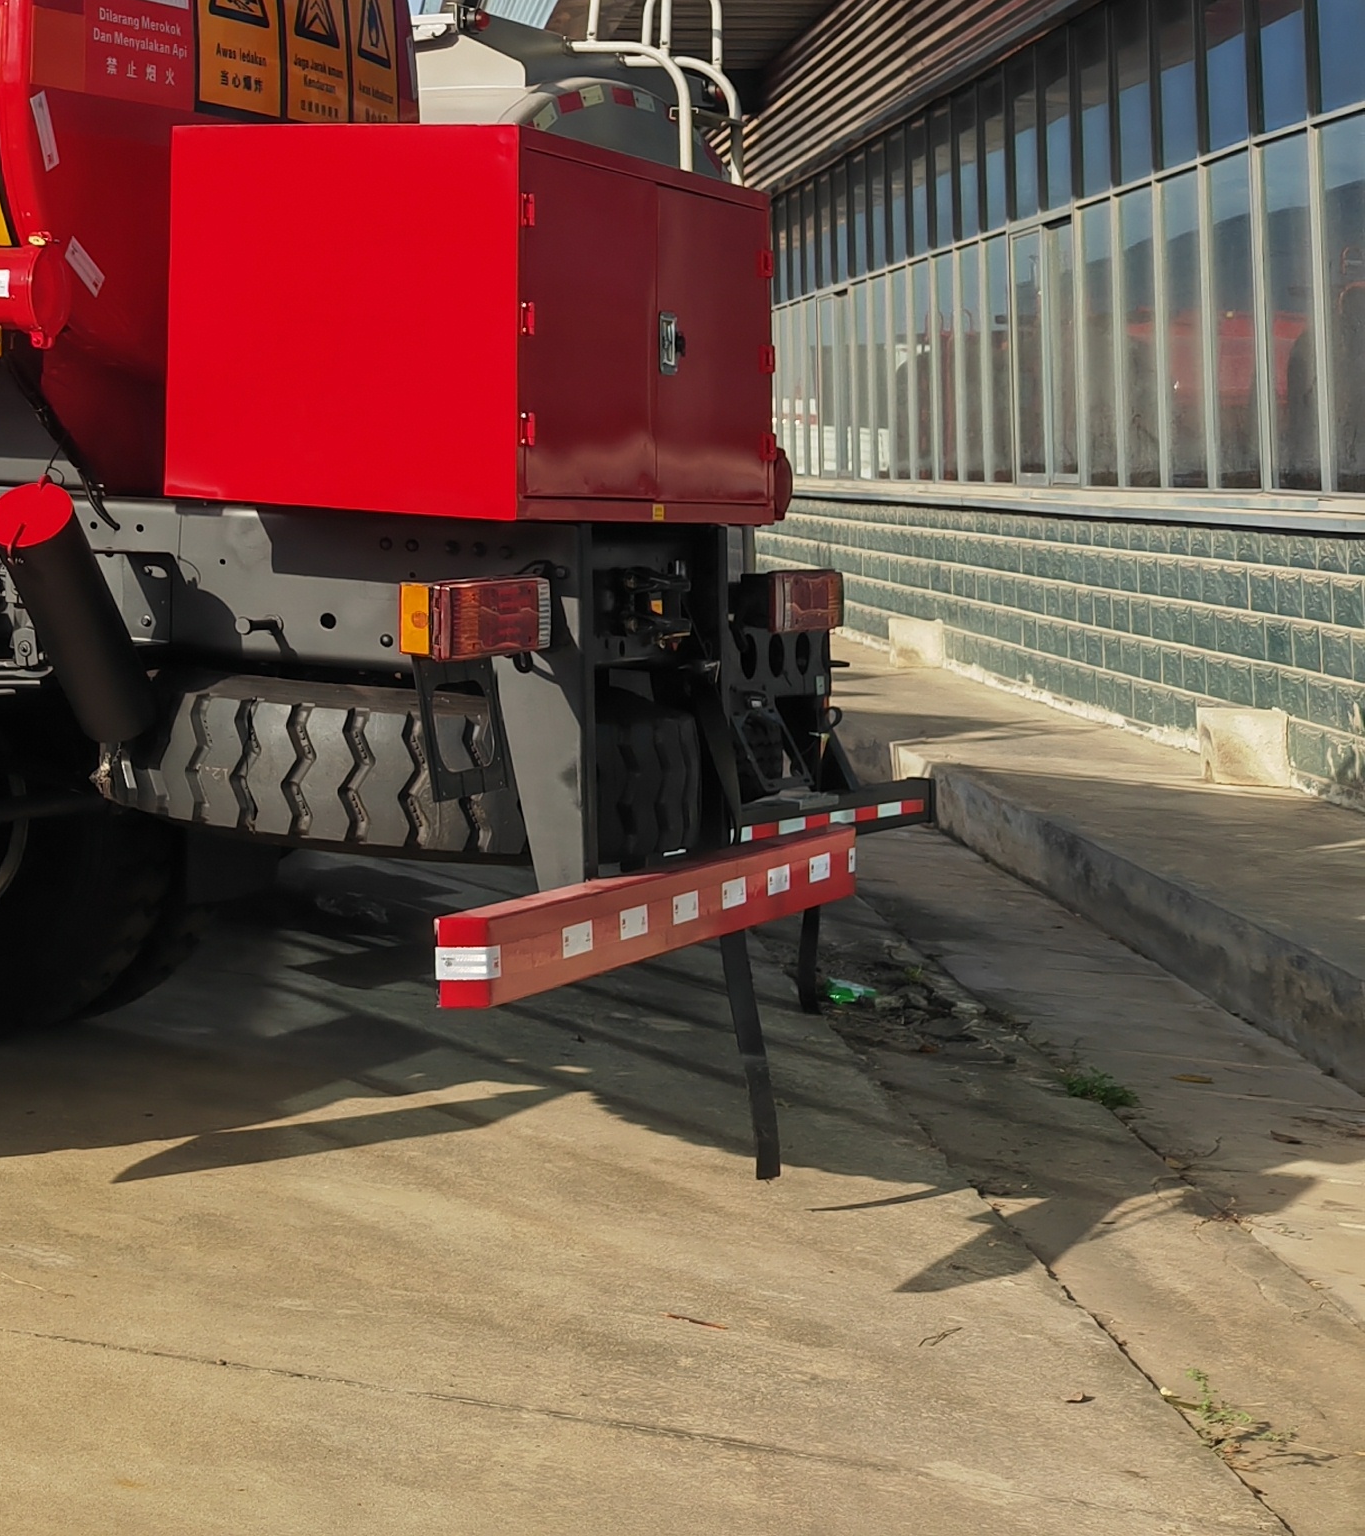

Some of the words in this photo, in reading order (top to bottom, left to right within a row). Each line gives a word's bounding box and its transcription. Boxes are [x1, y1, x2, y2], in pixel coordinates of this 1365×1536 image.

[98, 7, 140, 30] Dilarang
[141, 16, 182, 36] Merokok
[93, 27, 112, 43] Dan
[114, 31, 170, 55] Menyalakan
[172, 44, 188, 59] Api
[216, 42, 236, 60] Awas
[239, 48, 267, 67] ledakan
[106, 57, 175, 86] 禁止烟火
[220, 69, 264, 94] 当心爆炸
